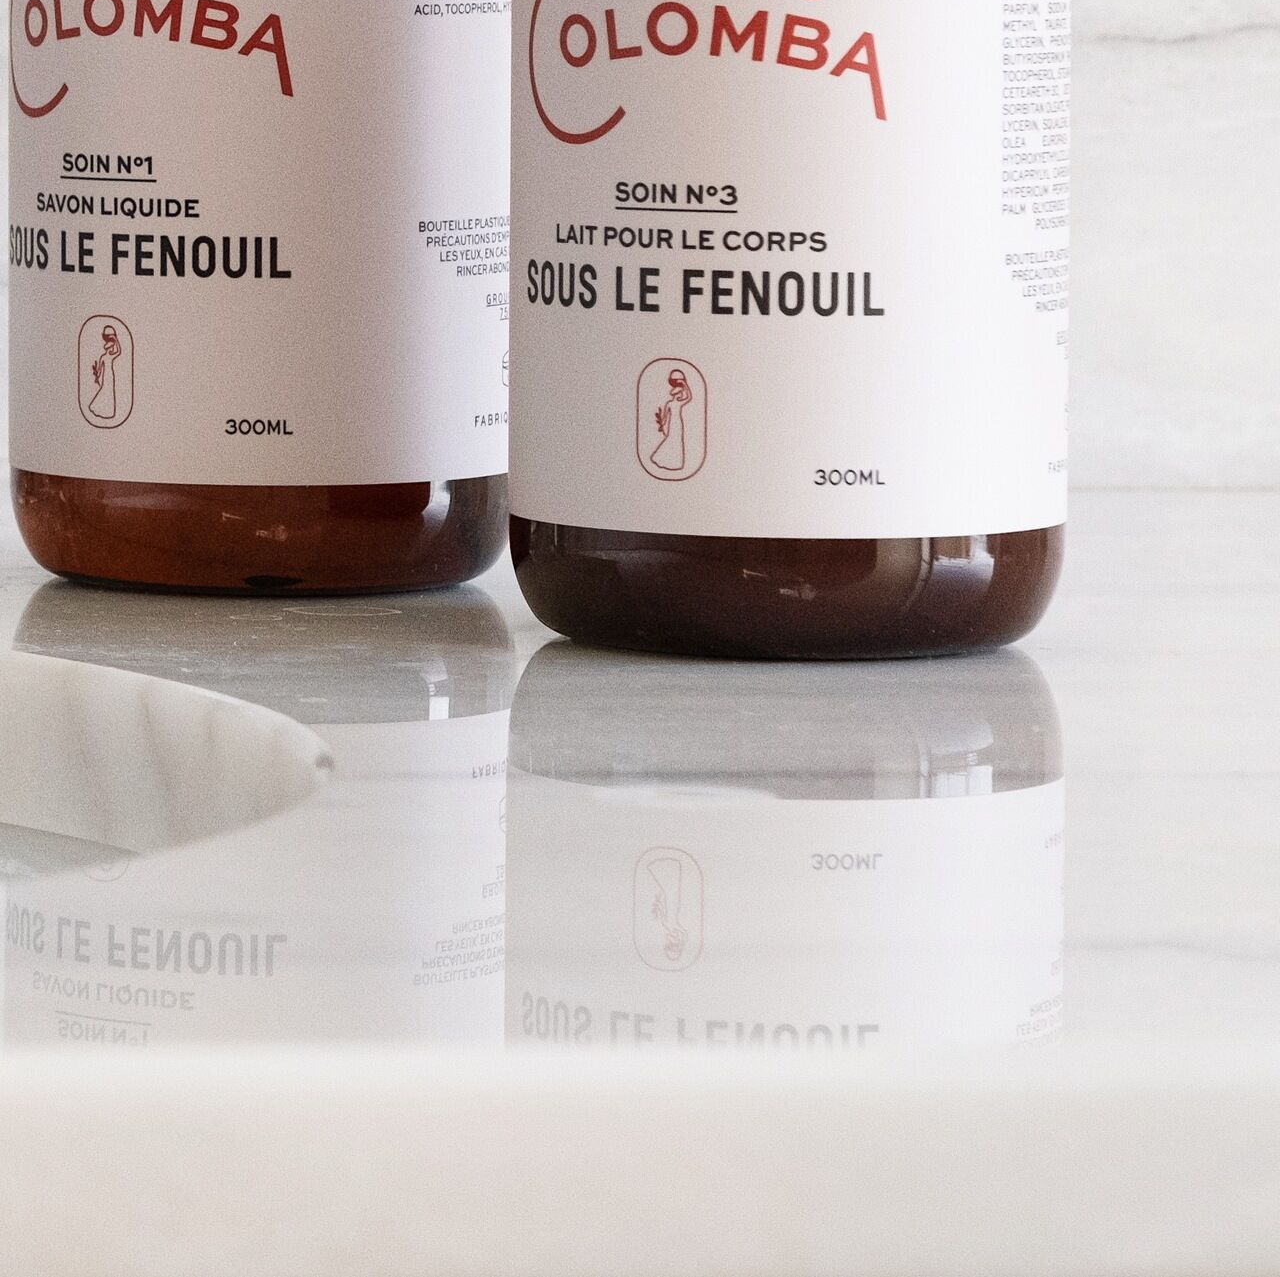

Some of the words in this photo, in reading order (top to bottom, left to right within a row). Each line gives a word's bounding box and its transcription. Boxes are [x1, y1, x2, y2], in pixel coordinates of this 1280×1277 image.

[414, 4, 444, 17] ACID,
[1002, 137, 1026, 148] OLEA
[62, 153, 110, 173] SOIN
[614, 181, 679, 205] SOIN
[37, 192, 94, 214] SAVON
[100, 197, 200, 219] LIQUIDE
[1002, 204, 1026, 214] PALM
[418, 219, 473, 233] BOUTEILLE
[426, 232, 490, 248] PRÉCAUTIONS
[555, 223, 598, 246] LAIT
[604, 227, 676, 250] POUR
[681, 229, 714, 251] LE
[722, 230, 828, 253] CORPS
[61, 231, 95, 274] LE
[111, 234, 292, 278] FENOUIL
[439, 250, 459, 263] LES
[460, 248, 484, 262] YEUX,
[485, 247, 495, 259] EN
[457, 264, 488, 276] RINCER
[527, 261, 597, 311] SOUS
[615, 266, 659, 313] LE
[682, 269, 884, 317] FENOUIL
[225, 418, 294, 436] 300ML
[813, 469, 885, 486] 300ML
